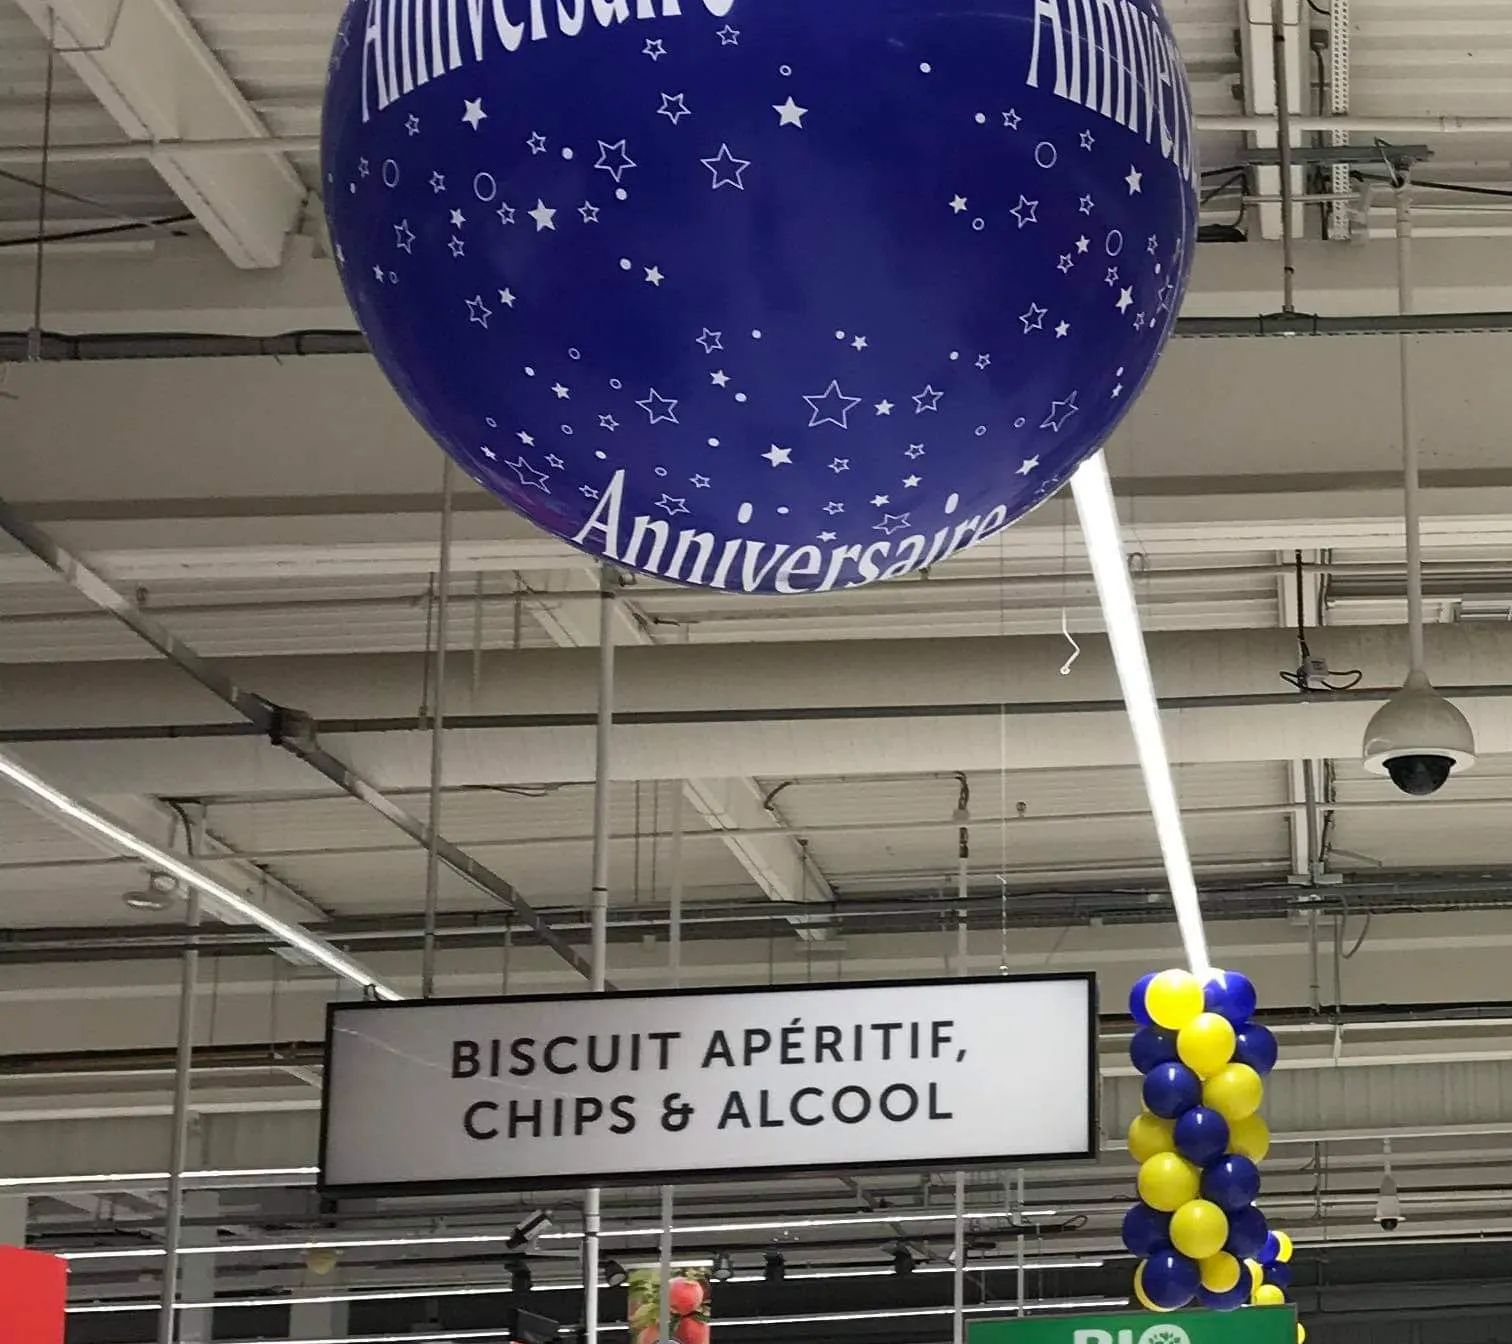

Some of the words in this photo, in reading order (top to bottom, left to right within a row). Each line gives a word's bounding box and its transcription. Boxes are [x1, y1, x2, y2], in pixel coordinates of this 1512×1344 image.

[450, 1029, 683, 1079] BISCUIT
[702, 1017, 969, 1068] APÉRITIF,
[462, 1094, 638, 1140] CHIPS
[660, 1091, 695, 1132] &
[717, 1080, 955, 1129] ALCOOL
